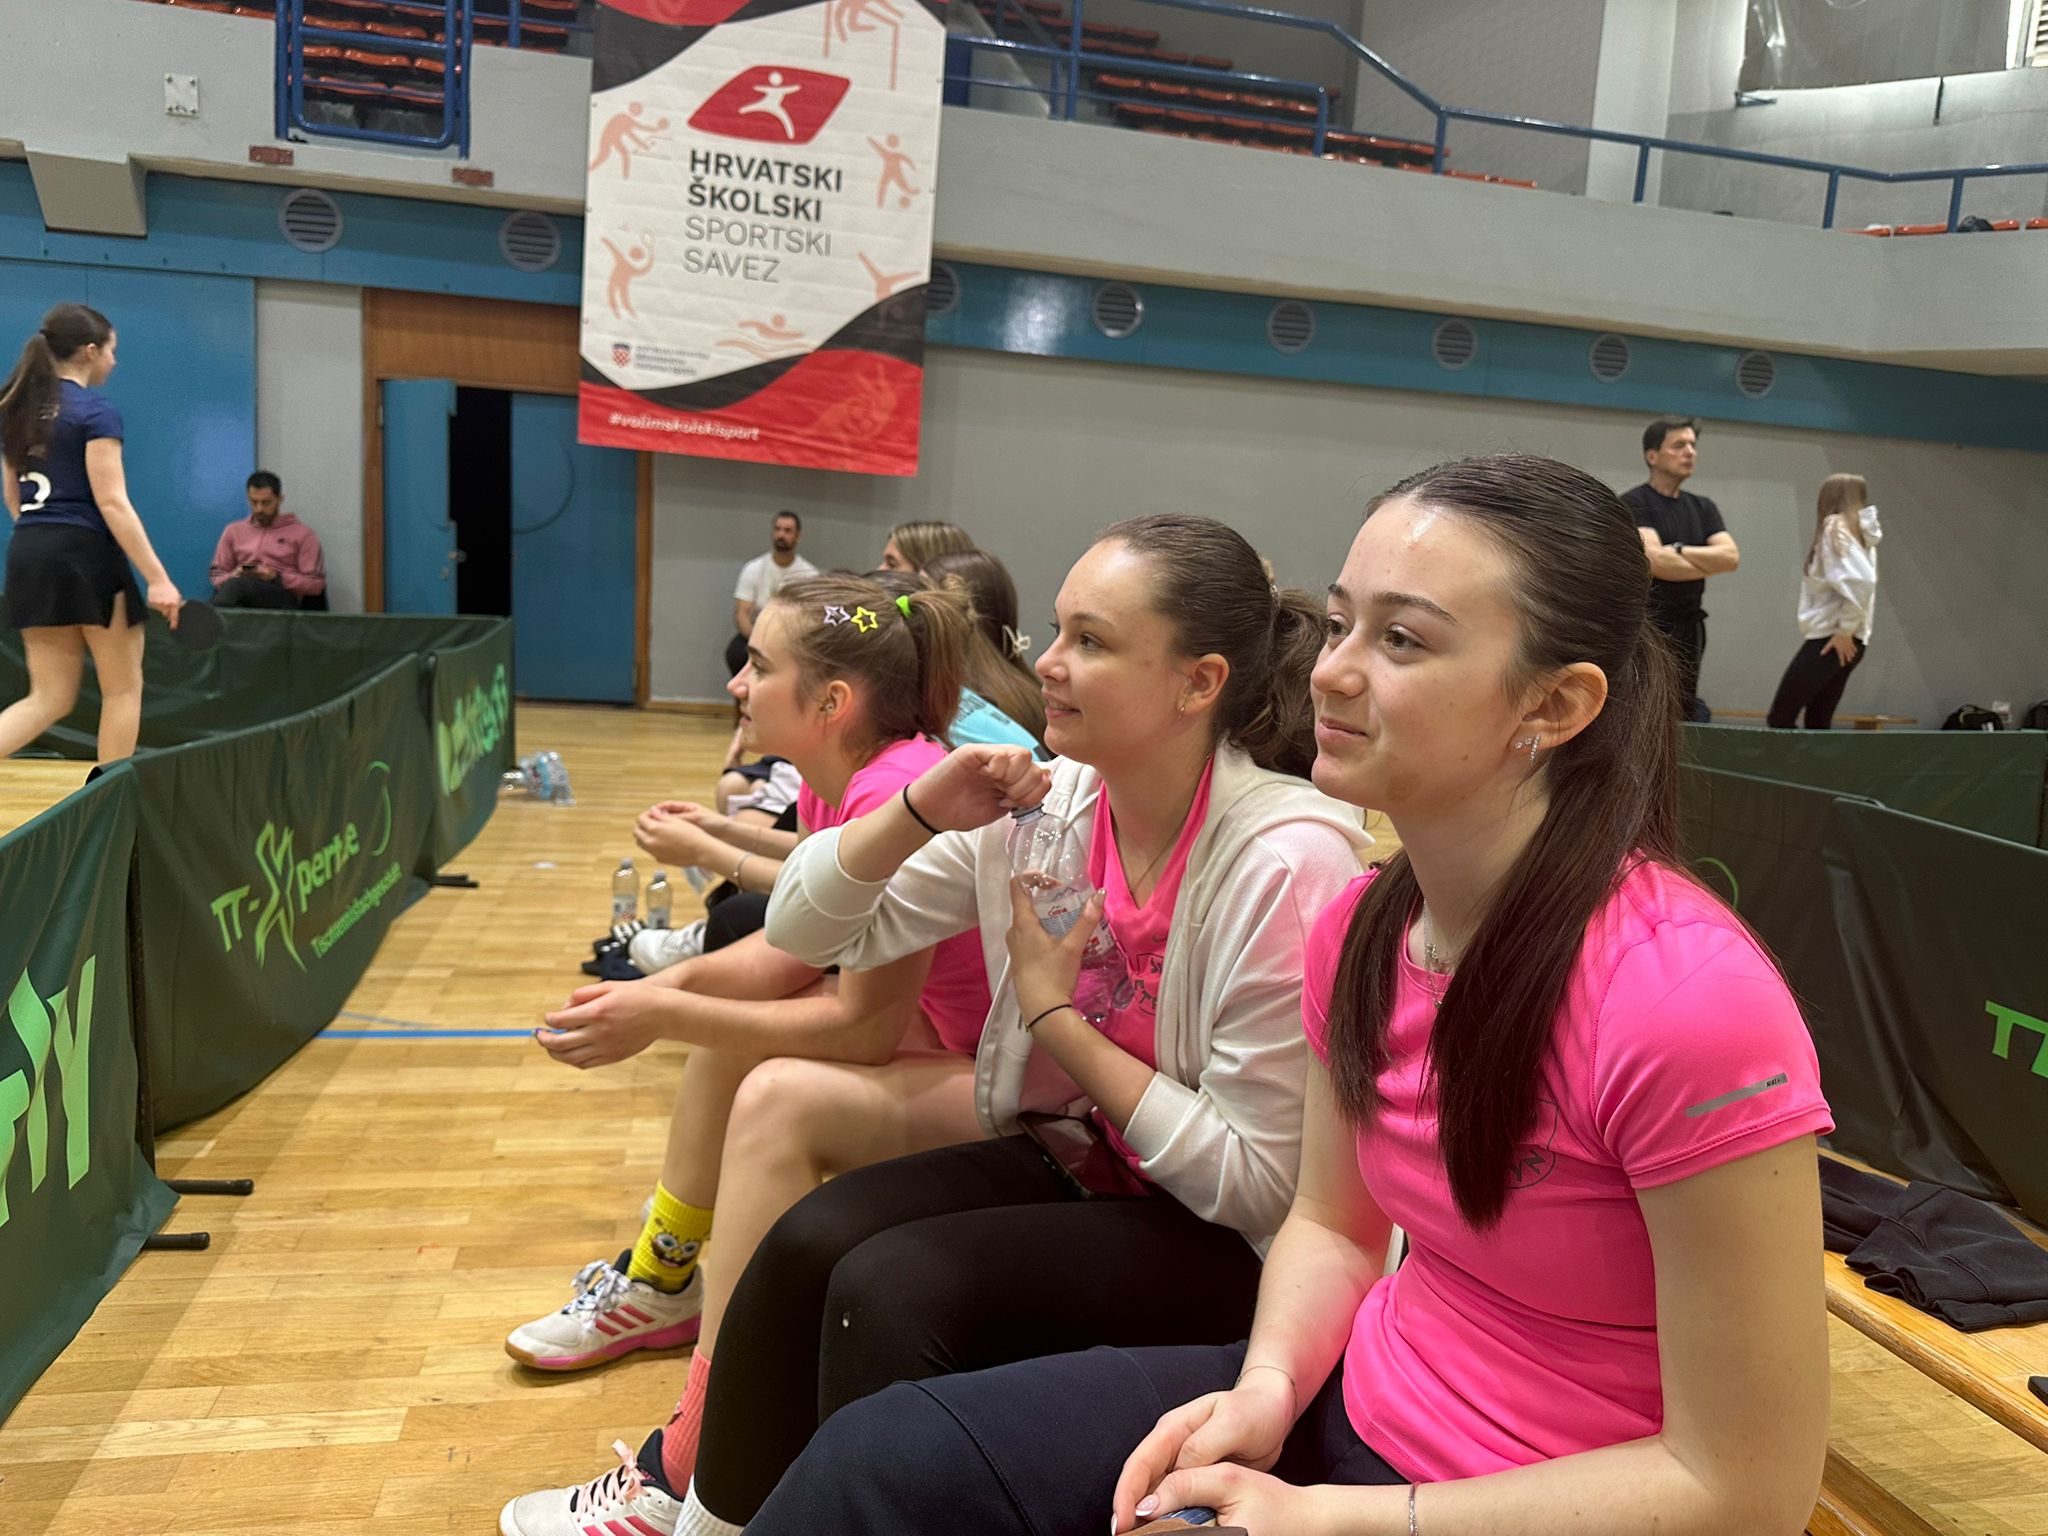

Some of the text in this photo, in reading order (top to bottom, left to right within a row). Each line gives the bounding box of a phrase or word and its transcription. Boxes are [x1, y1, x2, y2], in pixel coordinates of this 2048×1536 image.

[690, 150, 843, 192] HRVATSKI
[688, 176, 822, 222] ŠKOLSKI
[685, 214, 831, 256] SPORTSKI
[683, 247, 781, 283] SAVEZ
